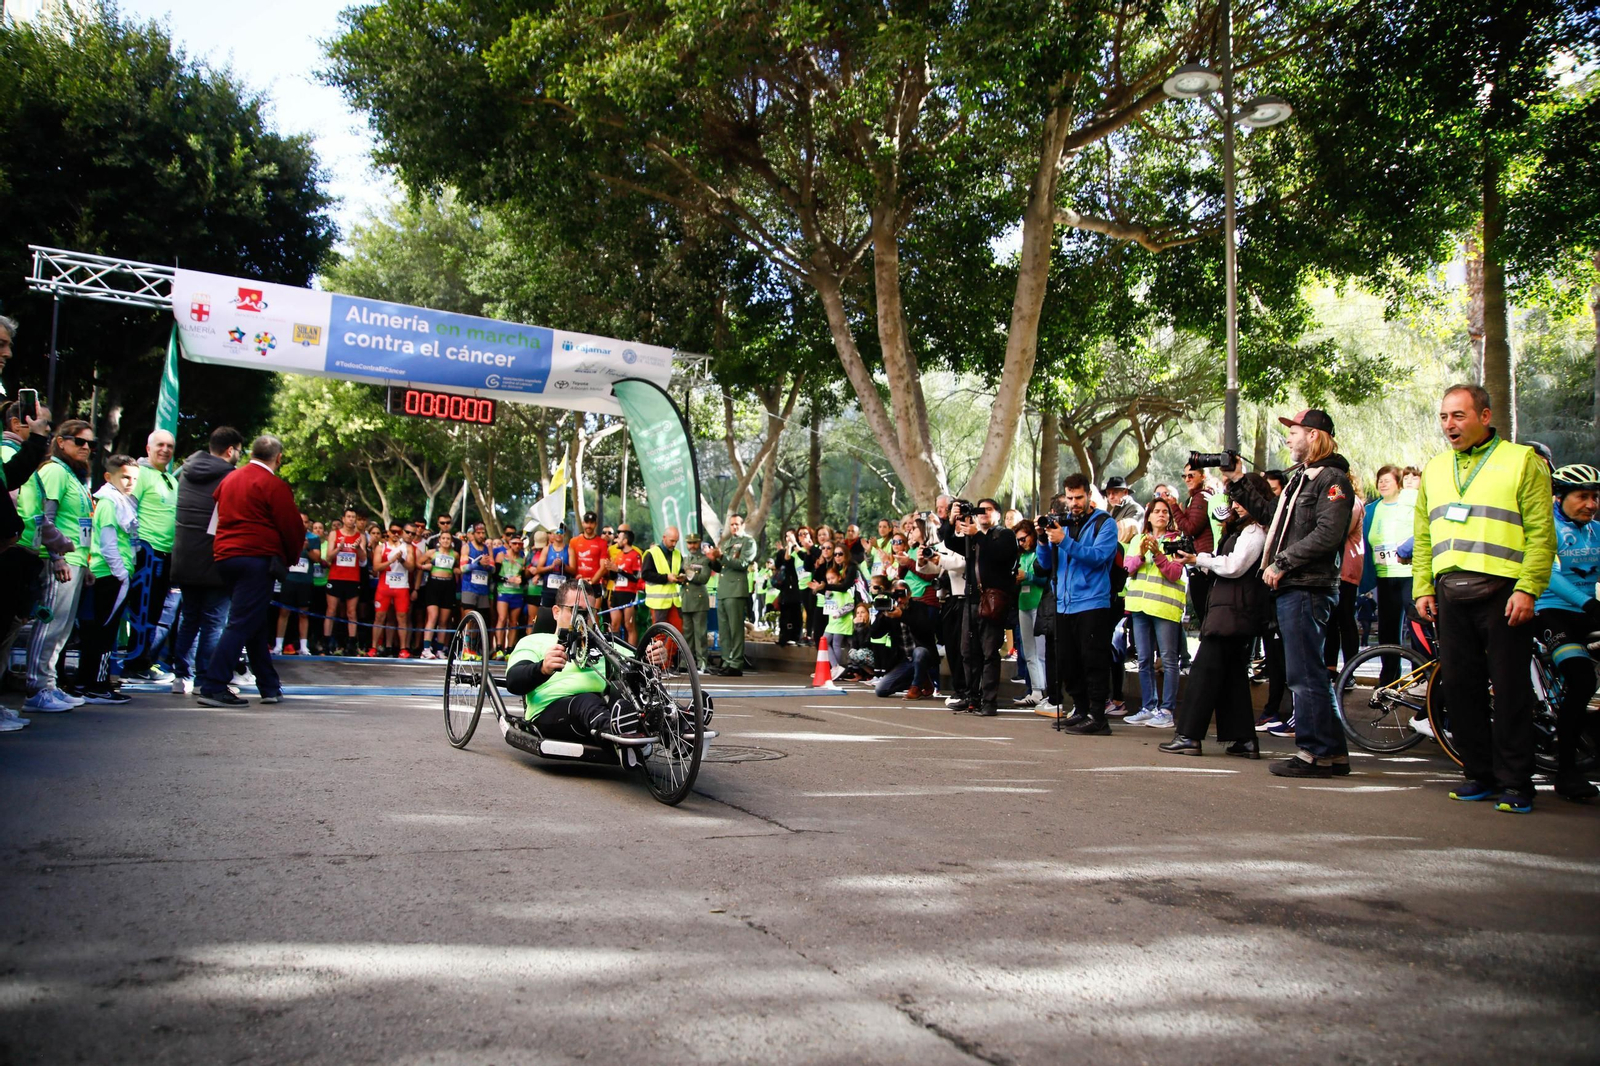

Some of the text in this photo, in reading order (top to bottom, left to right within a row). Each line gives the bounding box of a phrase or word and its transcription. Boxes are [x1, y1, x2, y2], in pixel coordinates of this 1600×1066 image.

[179, 323, 216, 335] ALMERÍA
[345, 305, 541, 349] Almería en marcha
[343, 331, 516, 368] contra el cáncer
[575, 343, 612, 355] cajamar
